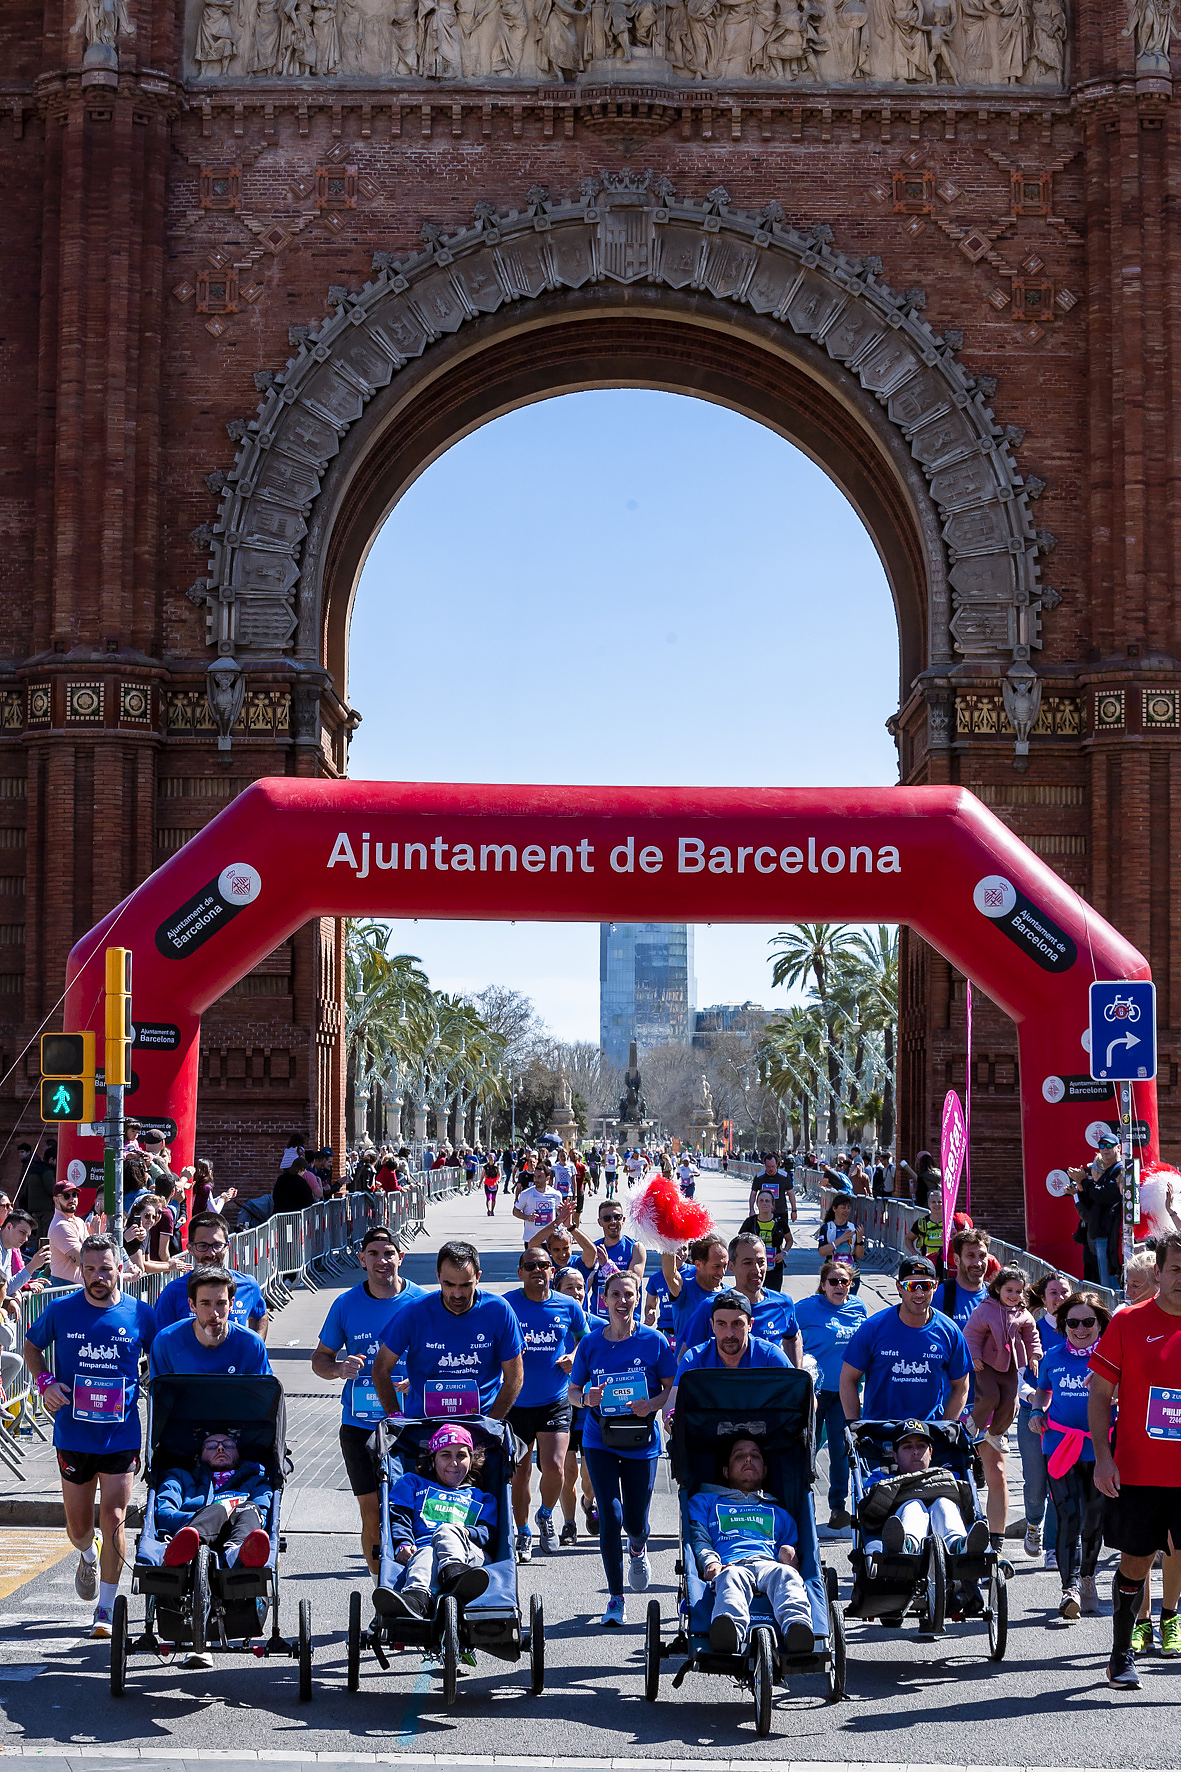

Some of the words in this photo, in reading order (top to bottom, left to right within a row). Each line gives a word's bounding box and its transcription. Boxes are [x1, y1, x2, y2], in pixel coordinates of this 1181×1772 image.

[327, 832, 595, 878] Ajuntament
[609, 836, 664, 873] de
[677, 837, 902, 874] Barcelona
[166, 903, 205, 940] Ajuntament
[204, 896, 215, 907] de
[172, 904, 224, 949] Barcelona
[1011, 916, 1059, 962] Barcelona
[1019, 909, 1058, 946] Ajuntament
[1056, 942, 1066, 953] de
[140, 1034, 175, 1044] Barcelona
[78, 1361, 118, 1370] #Imparables
[90, 1393, 108, 1402] MARC
